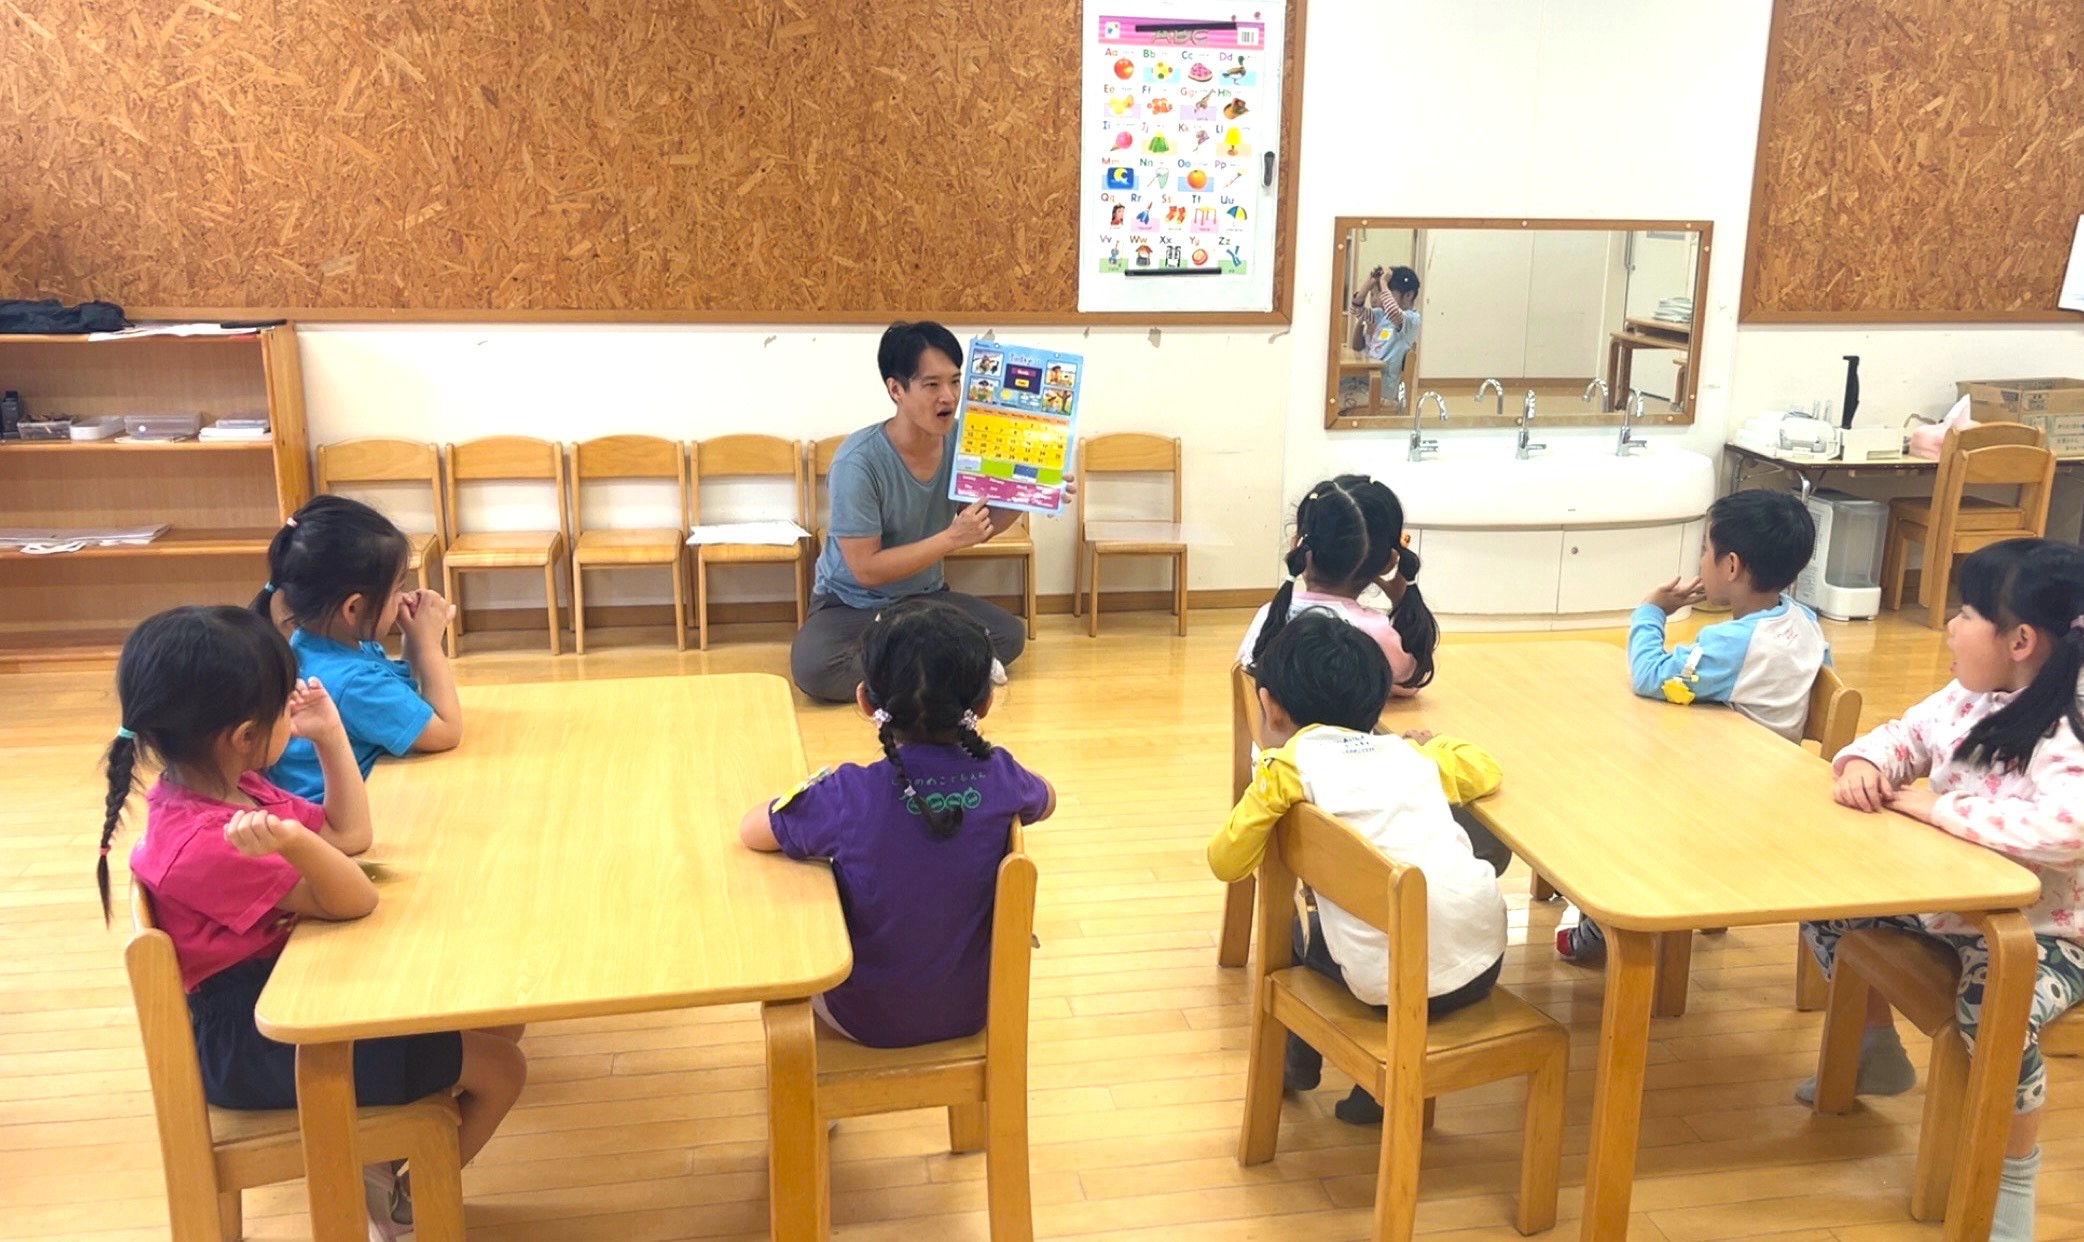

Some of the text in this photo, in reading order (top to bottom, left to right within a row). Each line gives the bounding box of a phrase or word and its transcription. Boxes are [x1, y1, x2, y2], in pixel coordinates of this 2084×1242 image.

[1105, 48, 1118, 56] Aa
[1143, 49, 1156, 58] Bb
[1181, 51, 1193, 60] Cc
[1219, 53, 1233, 61] Dd
[1104, 85, 1115, 94] Ee
[1142, 85, 1151, 94] Ff
[1180, 87, 1194, 97] Gg
[1218, 89, 1231, 97] Hh
[1103, 121, 1111, 130] Ii
[1141, 122, 1149, 132] Jj
[1178, 124, 1189, 132] Kk
[1140, 158, 1153, 167] Nn
[1177, 159, 1191, 168] Oo
[1215, 160, 1226, 169] Pp
[1101, 193, 1234, 204] Qq Rr Ss Tt Uu
[1100, 235, 1231, 246] Vv Ww Xx Yy Zz
